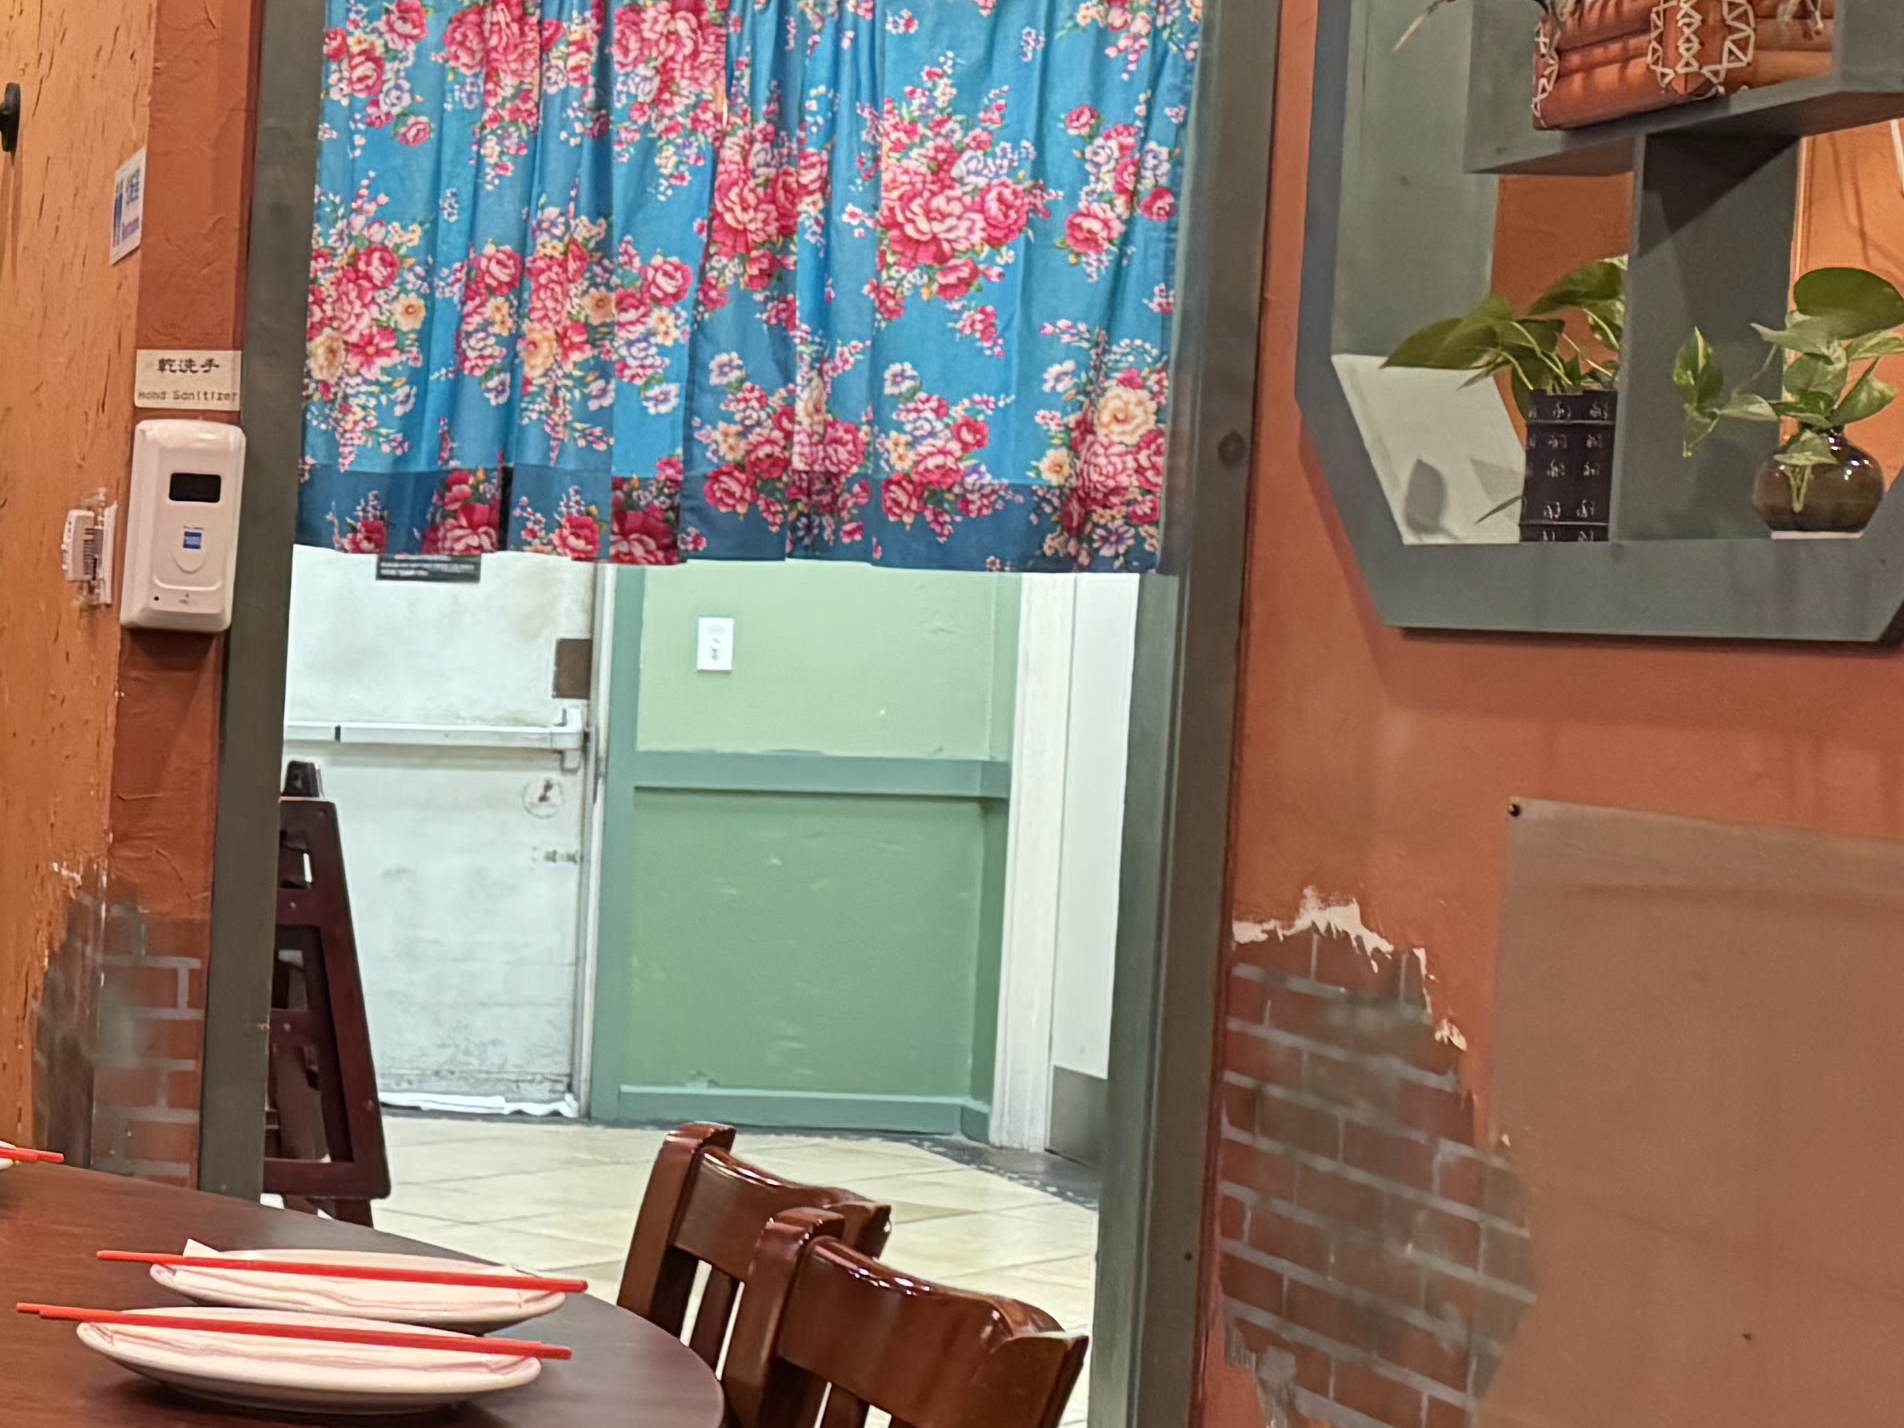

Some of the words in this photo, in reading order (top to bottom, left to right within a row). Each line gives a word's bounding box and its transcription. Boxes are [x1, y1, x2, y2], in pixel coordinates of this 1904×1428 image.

[157, 358, 220, 374] 乾洗手
[137, 389, 167, 401] Hand
[172, 389, 238, 403] Sanitizer
